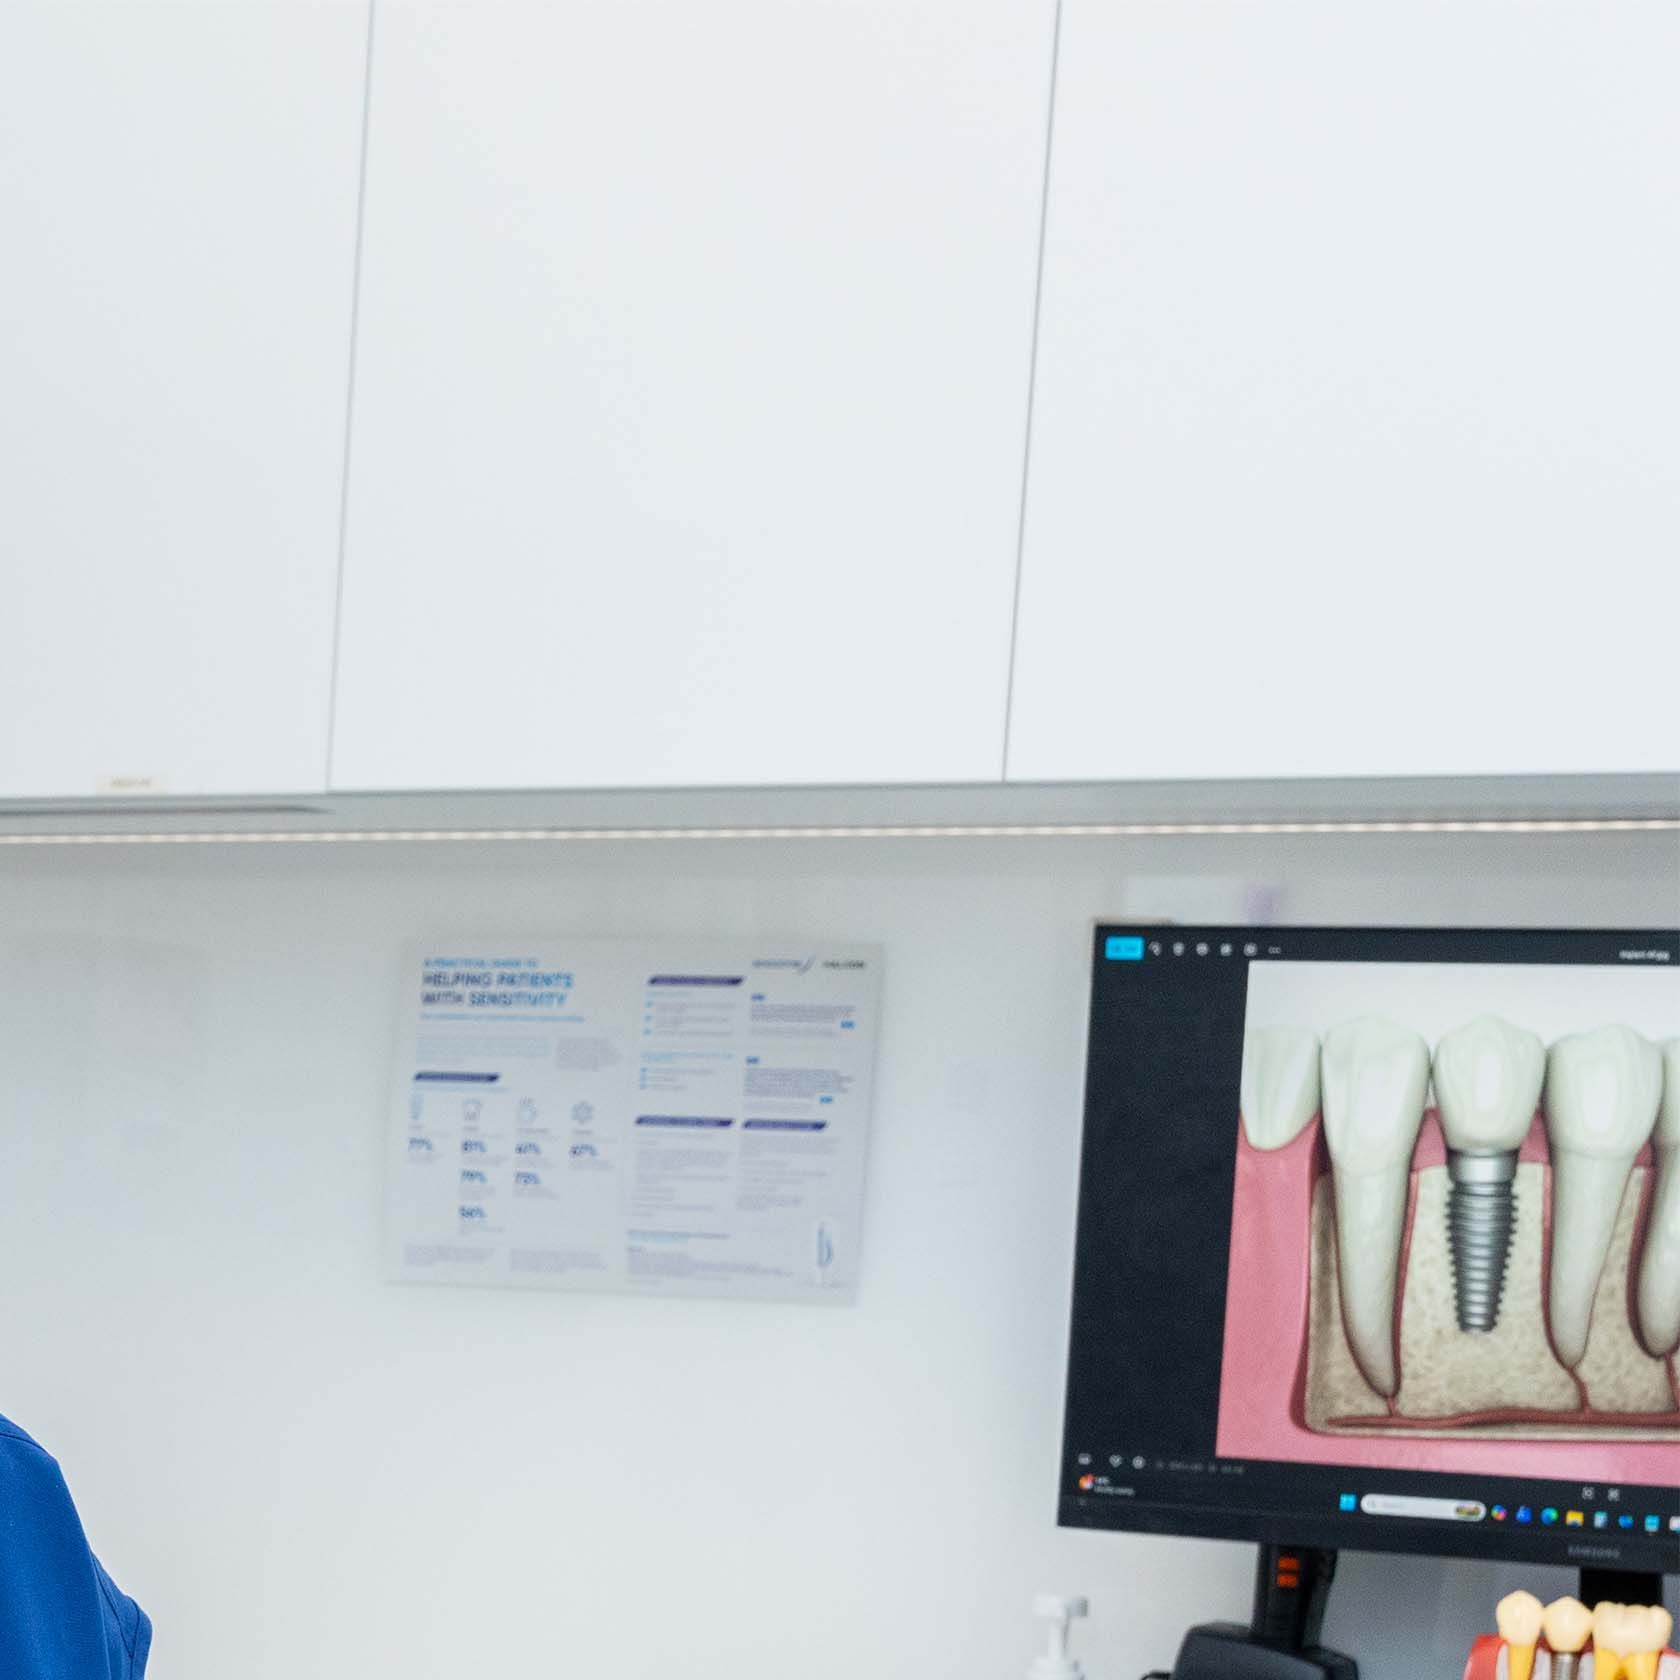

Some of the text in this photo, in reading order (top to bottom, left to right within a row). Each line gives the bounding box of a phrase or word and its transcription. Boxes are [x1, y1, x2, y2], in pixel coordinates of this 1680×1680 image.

[421, 972, 574, 988] HELPING PATIENTS
[420, 991, 568, 1007] WITH SENSITIVITY
